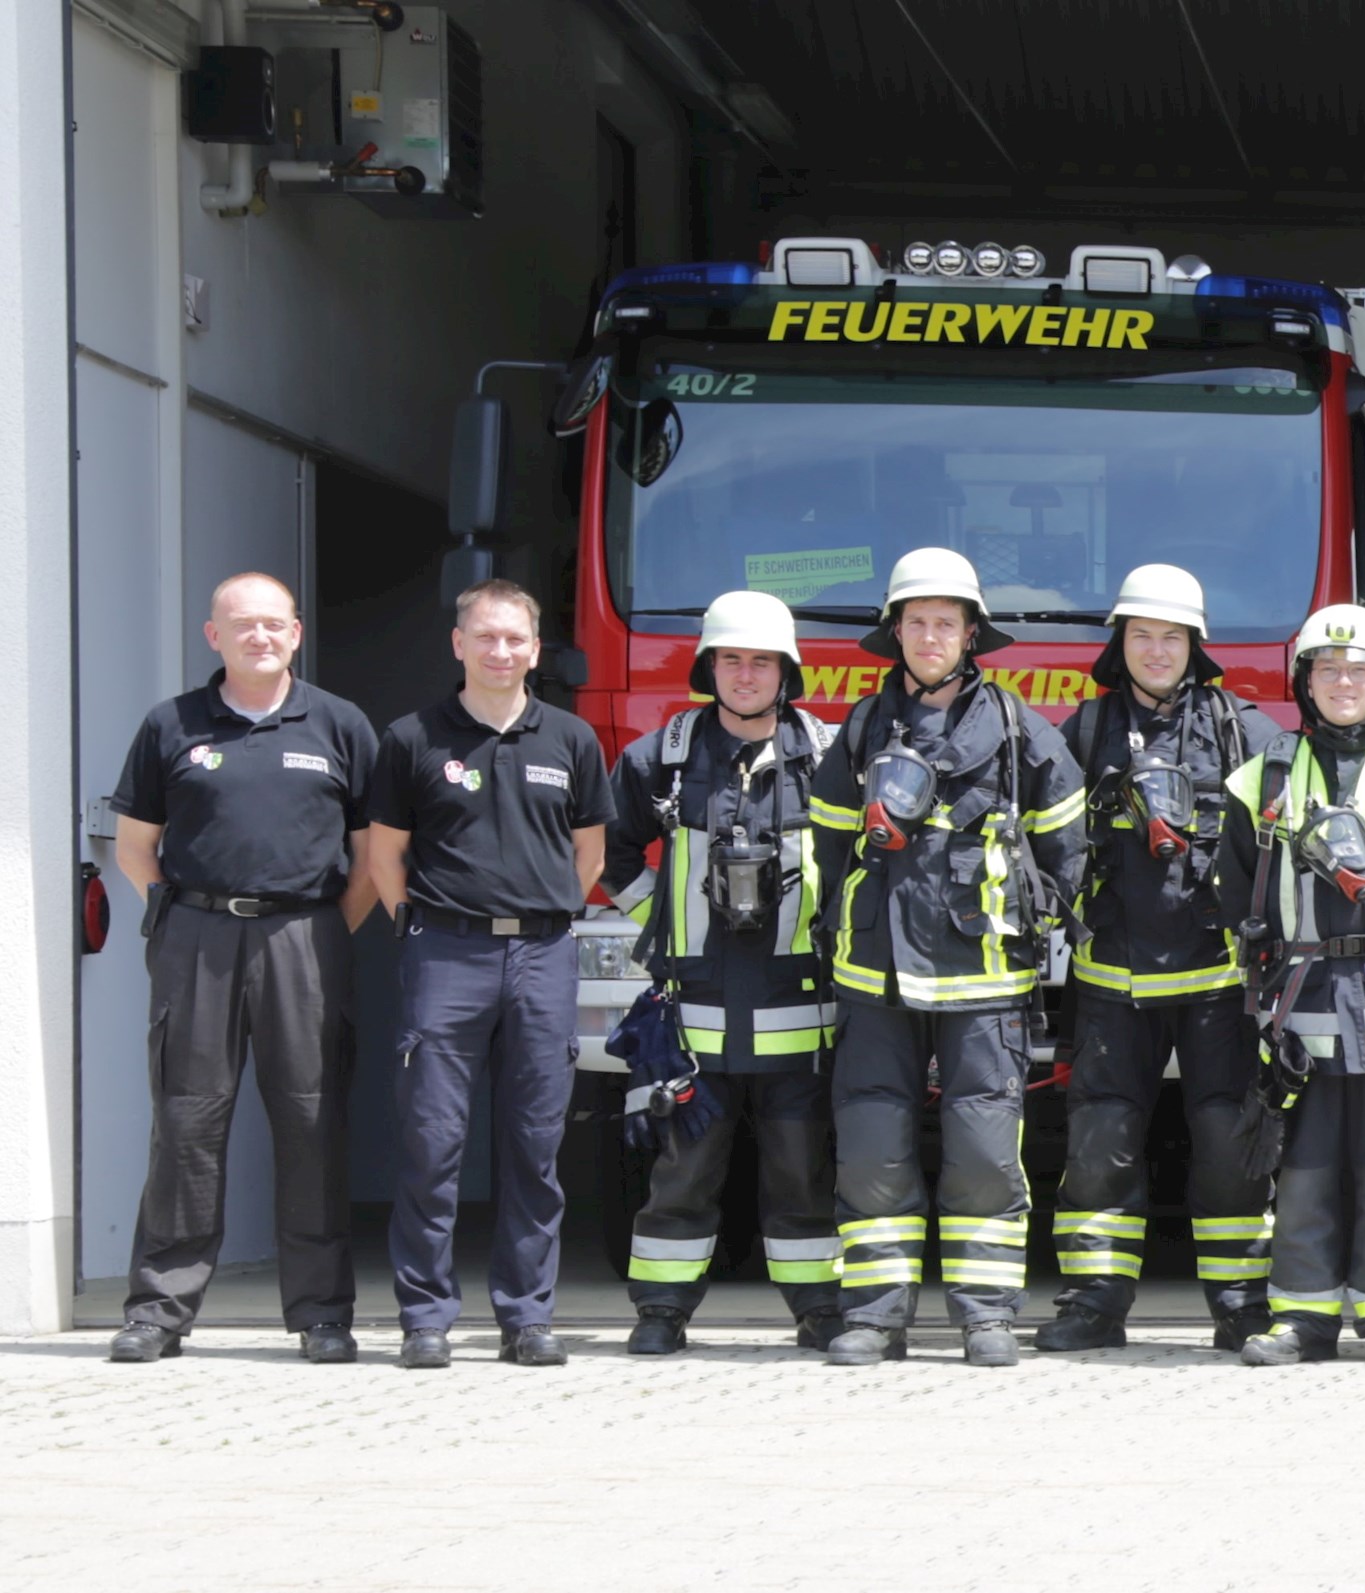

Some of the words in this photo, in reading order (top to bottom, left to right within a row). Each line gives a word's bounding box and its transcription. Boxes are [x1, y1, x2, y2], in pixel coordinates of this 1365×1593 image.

[768, 301, 1154, 350] FEUERWEHR
[667, 374, 756, 396] 40/2
[748, 561, 760, 576] FF
[763, 553, 870, 575] SCHWEITENKIRCHEN
